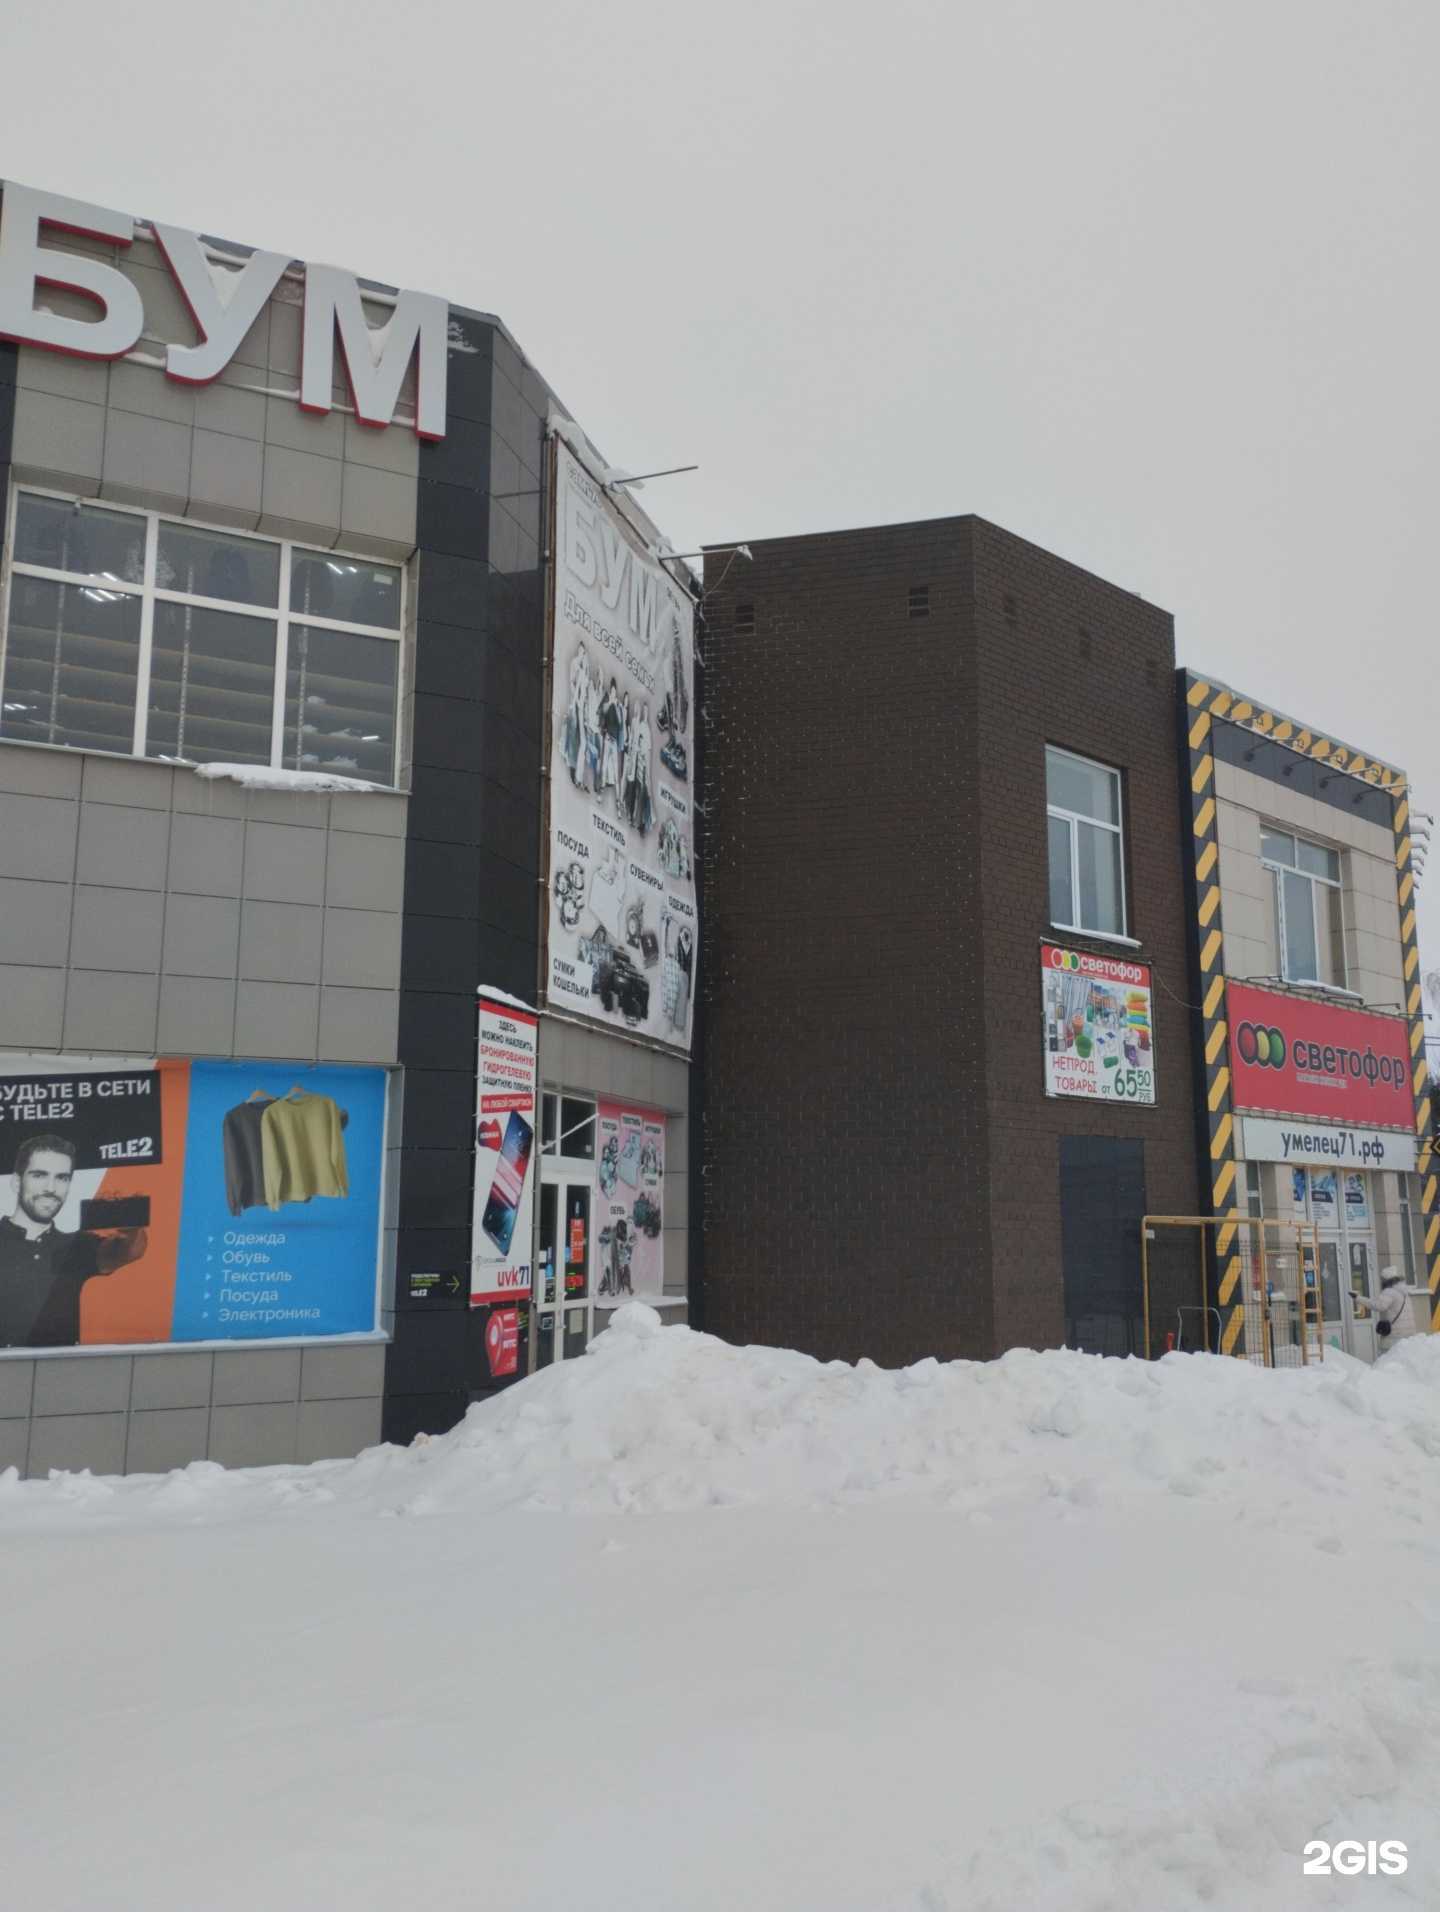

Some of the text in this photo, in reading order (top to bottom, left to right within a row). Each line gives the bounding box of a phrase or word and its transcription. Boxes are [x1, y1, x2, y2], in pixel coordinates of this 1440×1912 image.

[0, 178, 449, 441] БУМ
[564, 482, 658, 656] БУМ
[592, 813, 626, 847] ТЕКСТИЛЬ
[557, 830, 590, 859] ПОСУДА
[629, 863, 665, 891] СУВЕНИРЫ
[668, 895, 695, 918] ОДЕЖДА
[553, 957, 577, 978] СУМКИ
[1080, 955, 1143, 984] светофор
[553, 974, 592, 1000] КОШЕЛЬКИ
[1293, 1039, 1406, 1092] светофор
[78, 1081, 93, 1098] В
[97, 1079, 151, 1097] СЕТИ
[1055, 1075, 1098, 1095] ТОВАРЫ
[1114, 1068, 1138, 1098] 65
[10, 1102, 75, 1121] TELE2
[99, 1136, 153, 1160] TELE2
[1281, 1131, 1385, 1166] умелец71.рф
[223, 1231, 287, 1247] Одежда
[222, 1250, 272, 1267] Обувь
[221, 1269, 294, 1283] Текстиль
[220, 1288, 279, 1305] Посуда
[218, 1306, 321, 1323] Электроника
